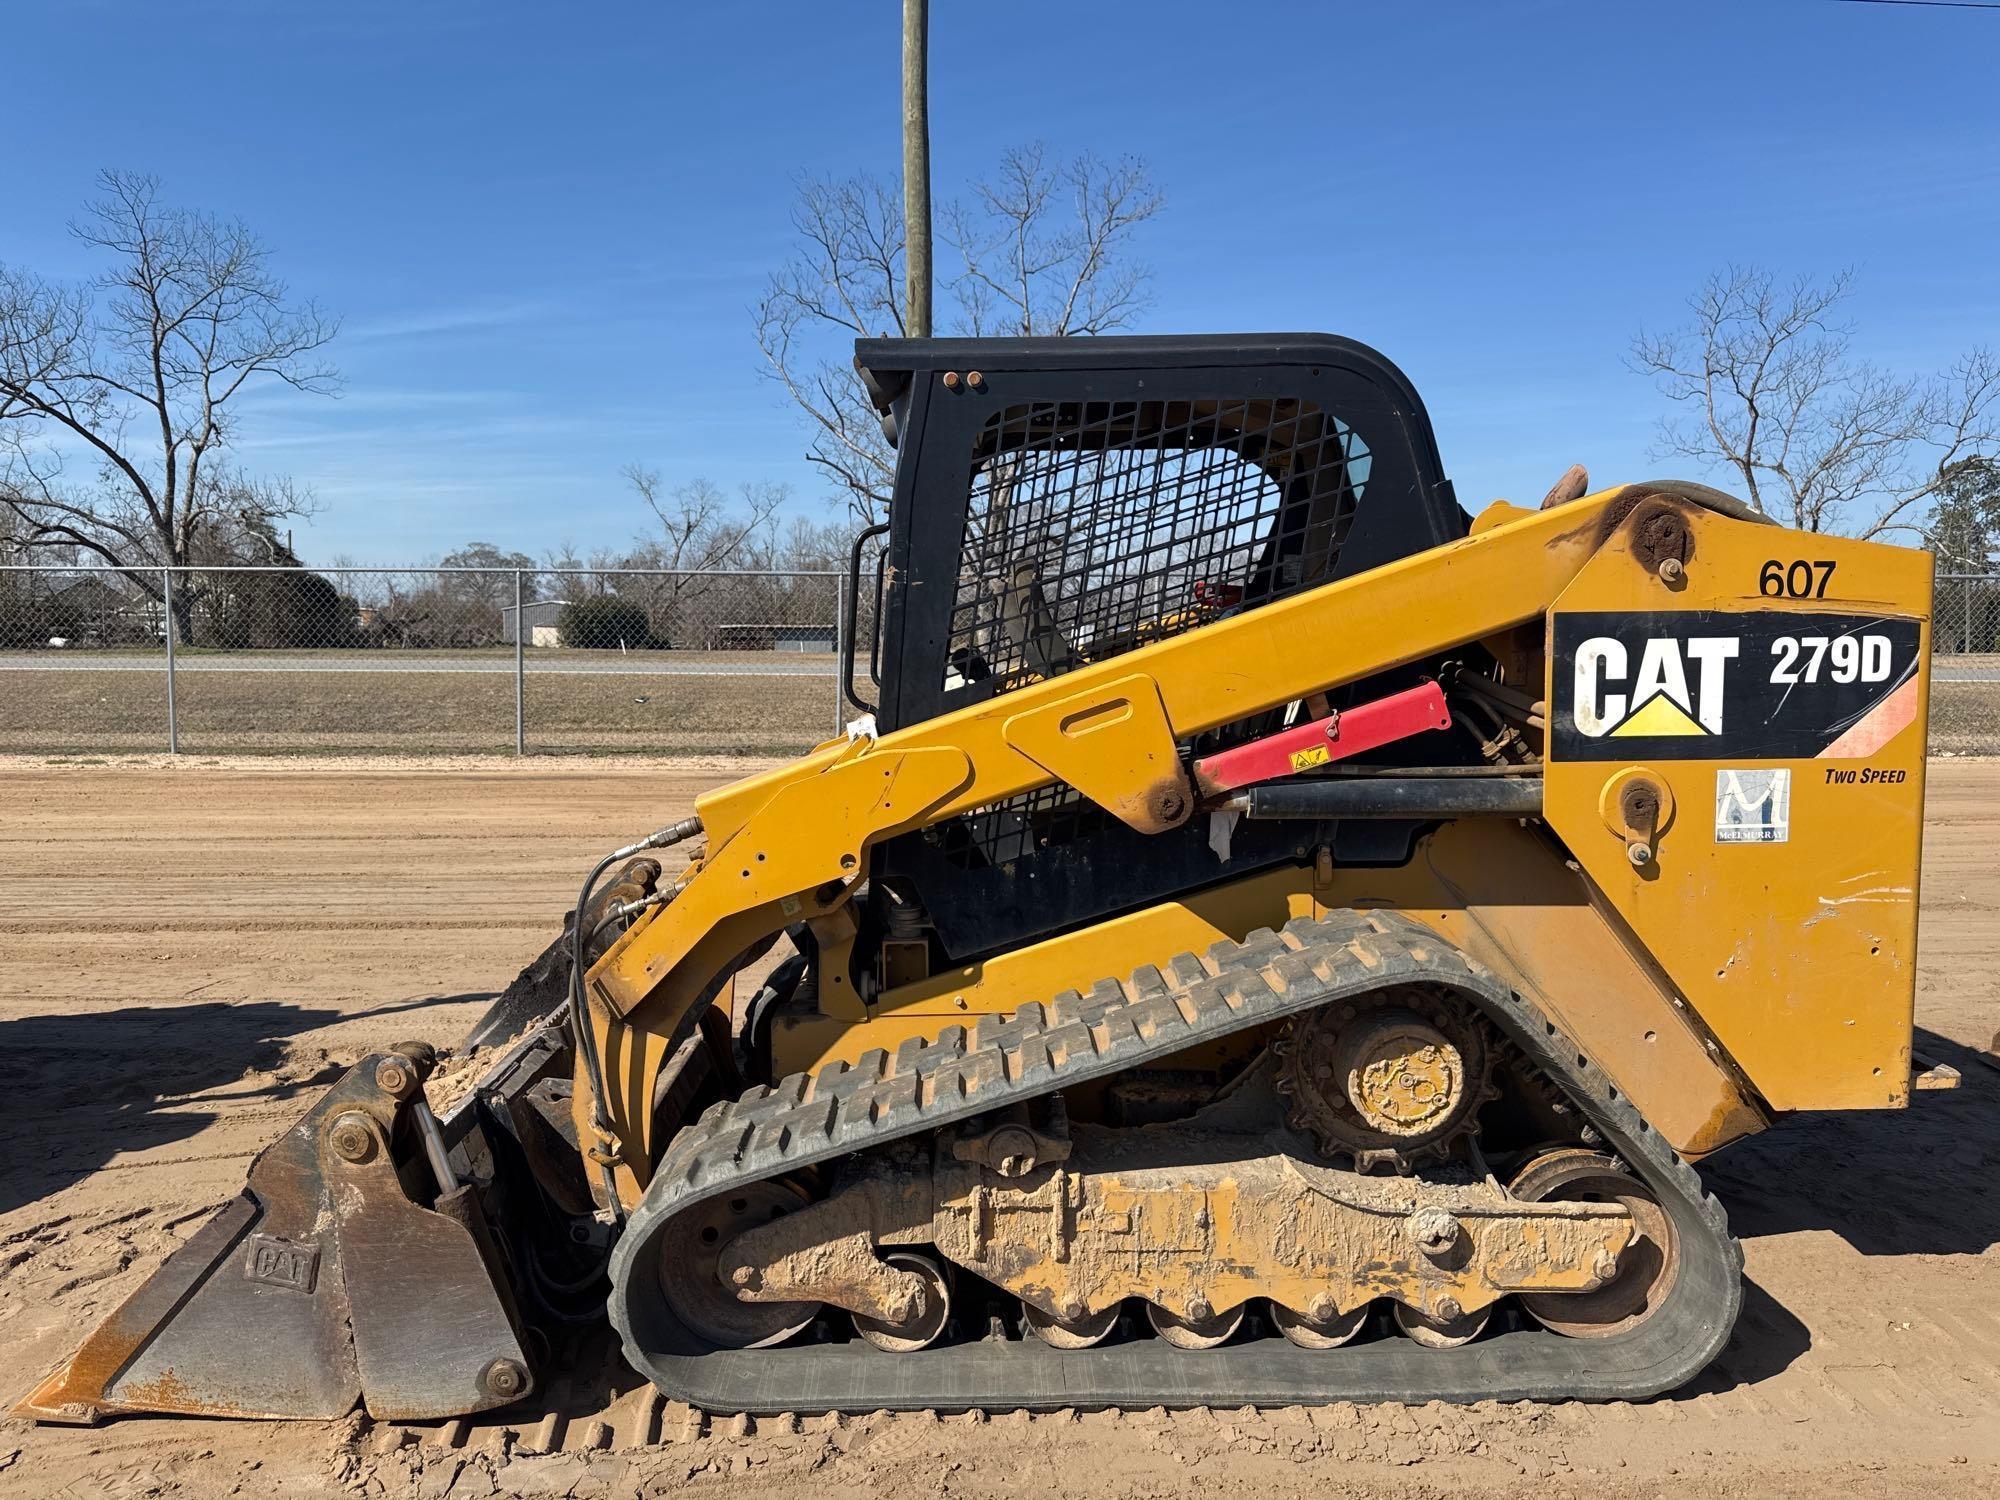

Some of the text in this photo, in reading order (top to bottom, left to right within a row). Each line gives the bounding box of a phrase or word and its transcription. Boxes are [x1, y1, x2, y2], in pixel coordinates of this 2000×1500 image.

[1759, 560, 1836, 599] 607
[1574, 635, 1892, 737] CAT 279D
[254, 1246, 309, 1284] CAT
